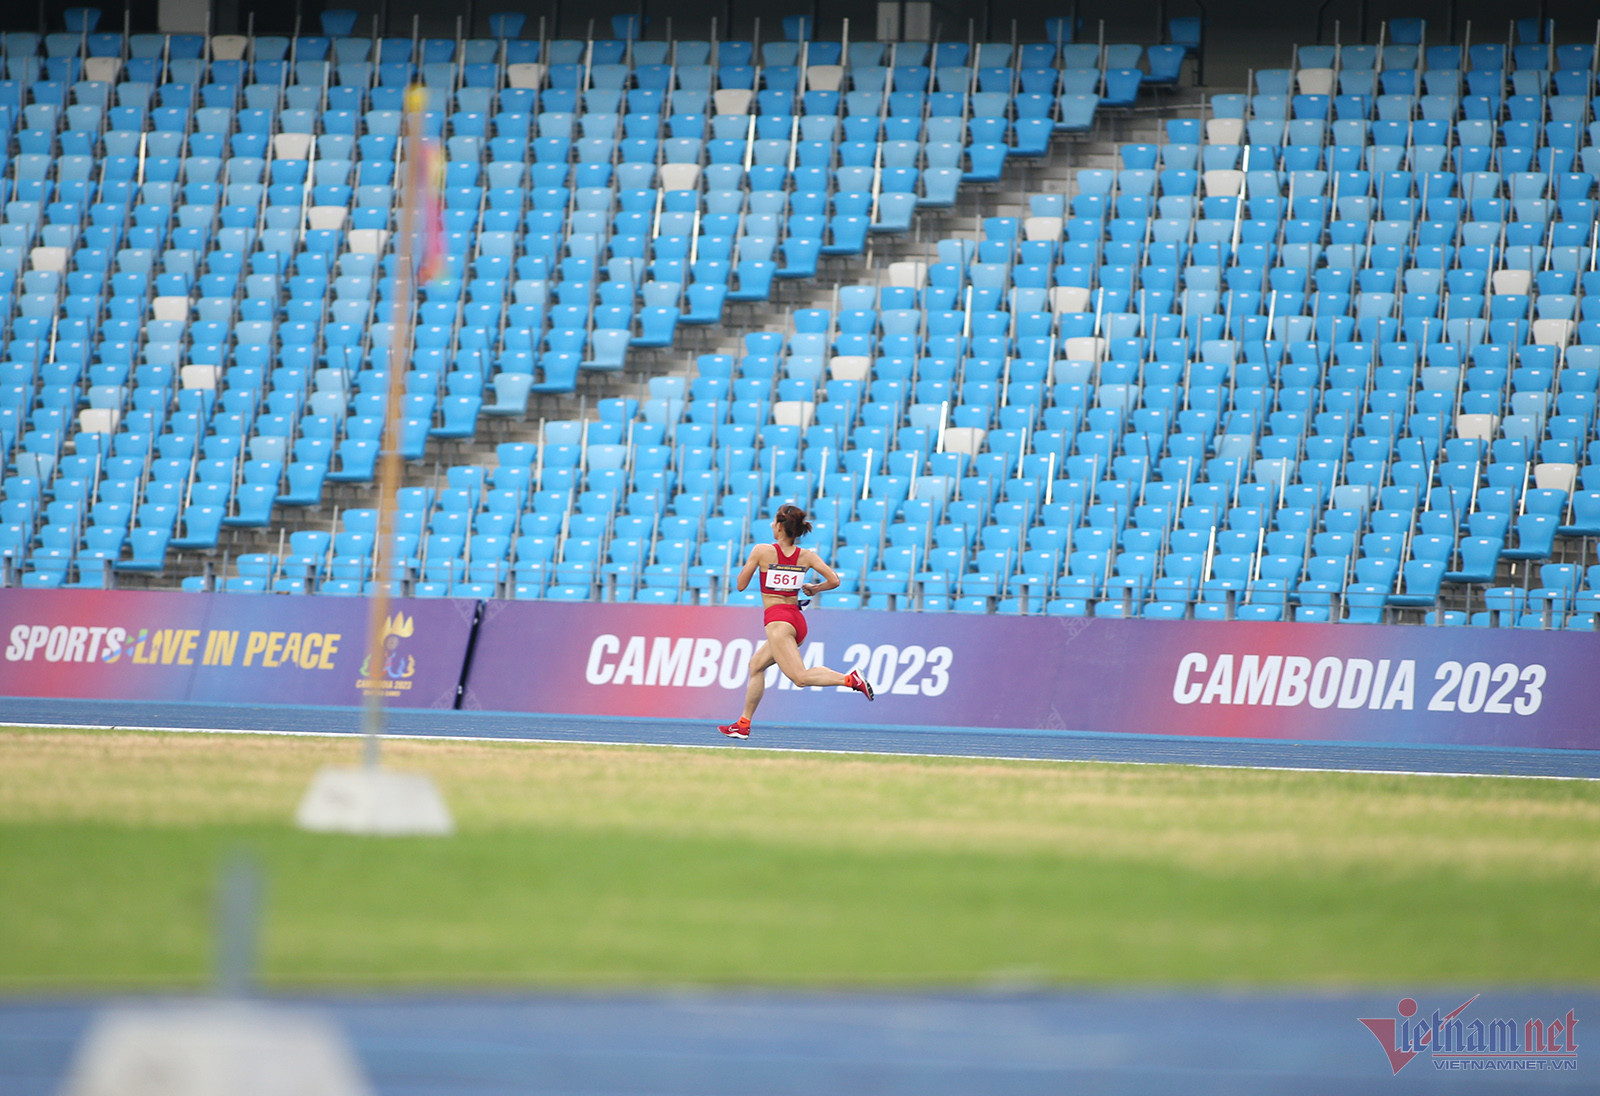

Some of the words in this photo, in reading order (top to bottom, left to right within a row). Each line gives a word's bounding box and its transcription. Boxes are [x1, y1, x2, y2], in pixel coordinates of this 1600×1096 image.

[773, 574, 798, 586] 561
[5, 625, 126, 663] SPORTS
[133, 629, 200, 665] LIVE
[202, 630, 239, 666] IN
[243, 631, 341, 670] PEACE
[836, 643, 953, 698] 2023
[1172, 652, 1416, 711] CAMBODIA
[1427, 660, 1547, 716] 2023
